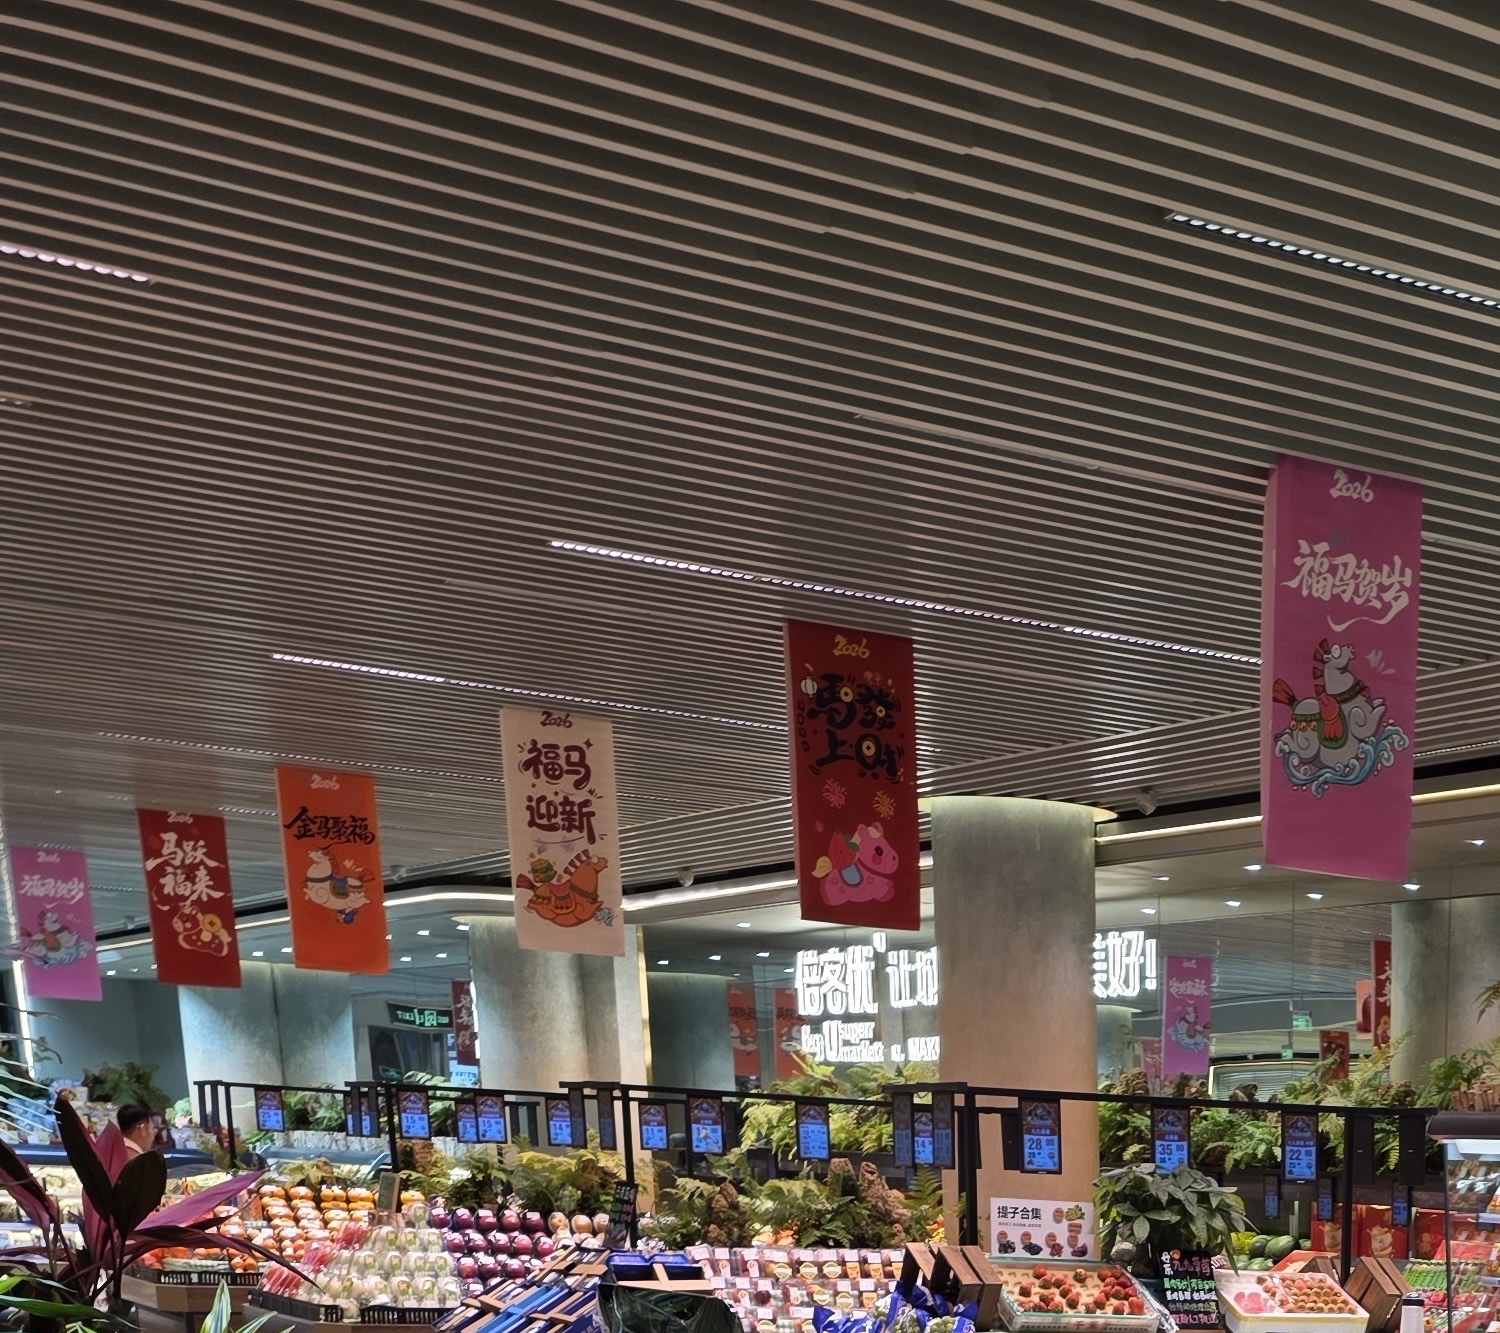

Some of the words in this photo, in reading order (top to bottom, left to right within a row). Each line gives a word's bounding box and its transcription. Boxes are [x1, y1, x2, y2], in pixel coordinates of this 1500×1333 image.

[1329, 468, 1374, 502] 2026
[1280, 539, 1413, 628] 福马贺岁
[832, 634, 870, 658] 2026
[540, 710, 573, 729] 2026
[522, 739, 592, 790] 福马
[310, 773, 340, 791] 2026
[284, 806, 376, 846] 金马聚福
[525, 795, 597, 845] 迎新
[146, 832, 225, 872] 马跃
[158, 866, 226, 901] 福来
[795, 945, 878, 1015] 倍客优
[1028, 1138, 1043, 1151] 28
[1158, 1143, 1172, 1156] 35
[1289, 1148, 1302, 1161] 22
[997, 1205, 1042, 1221] 提子合集
